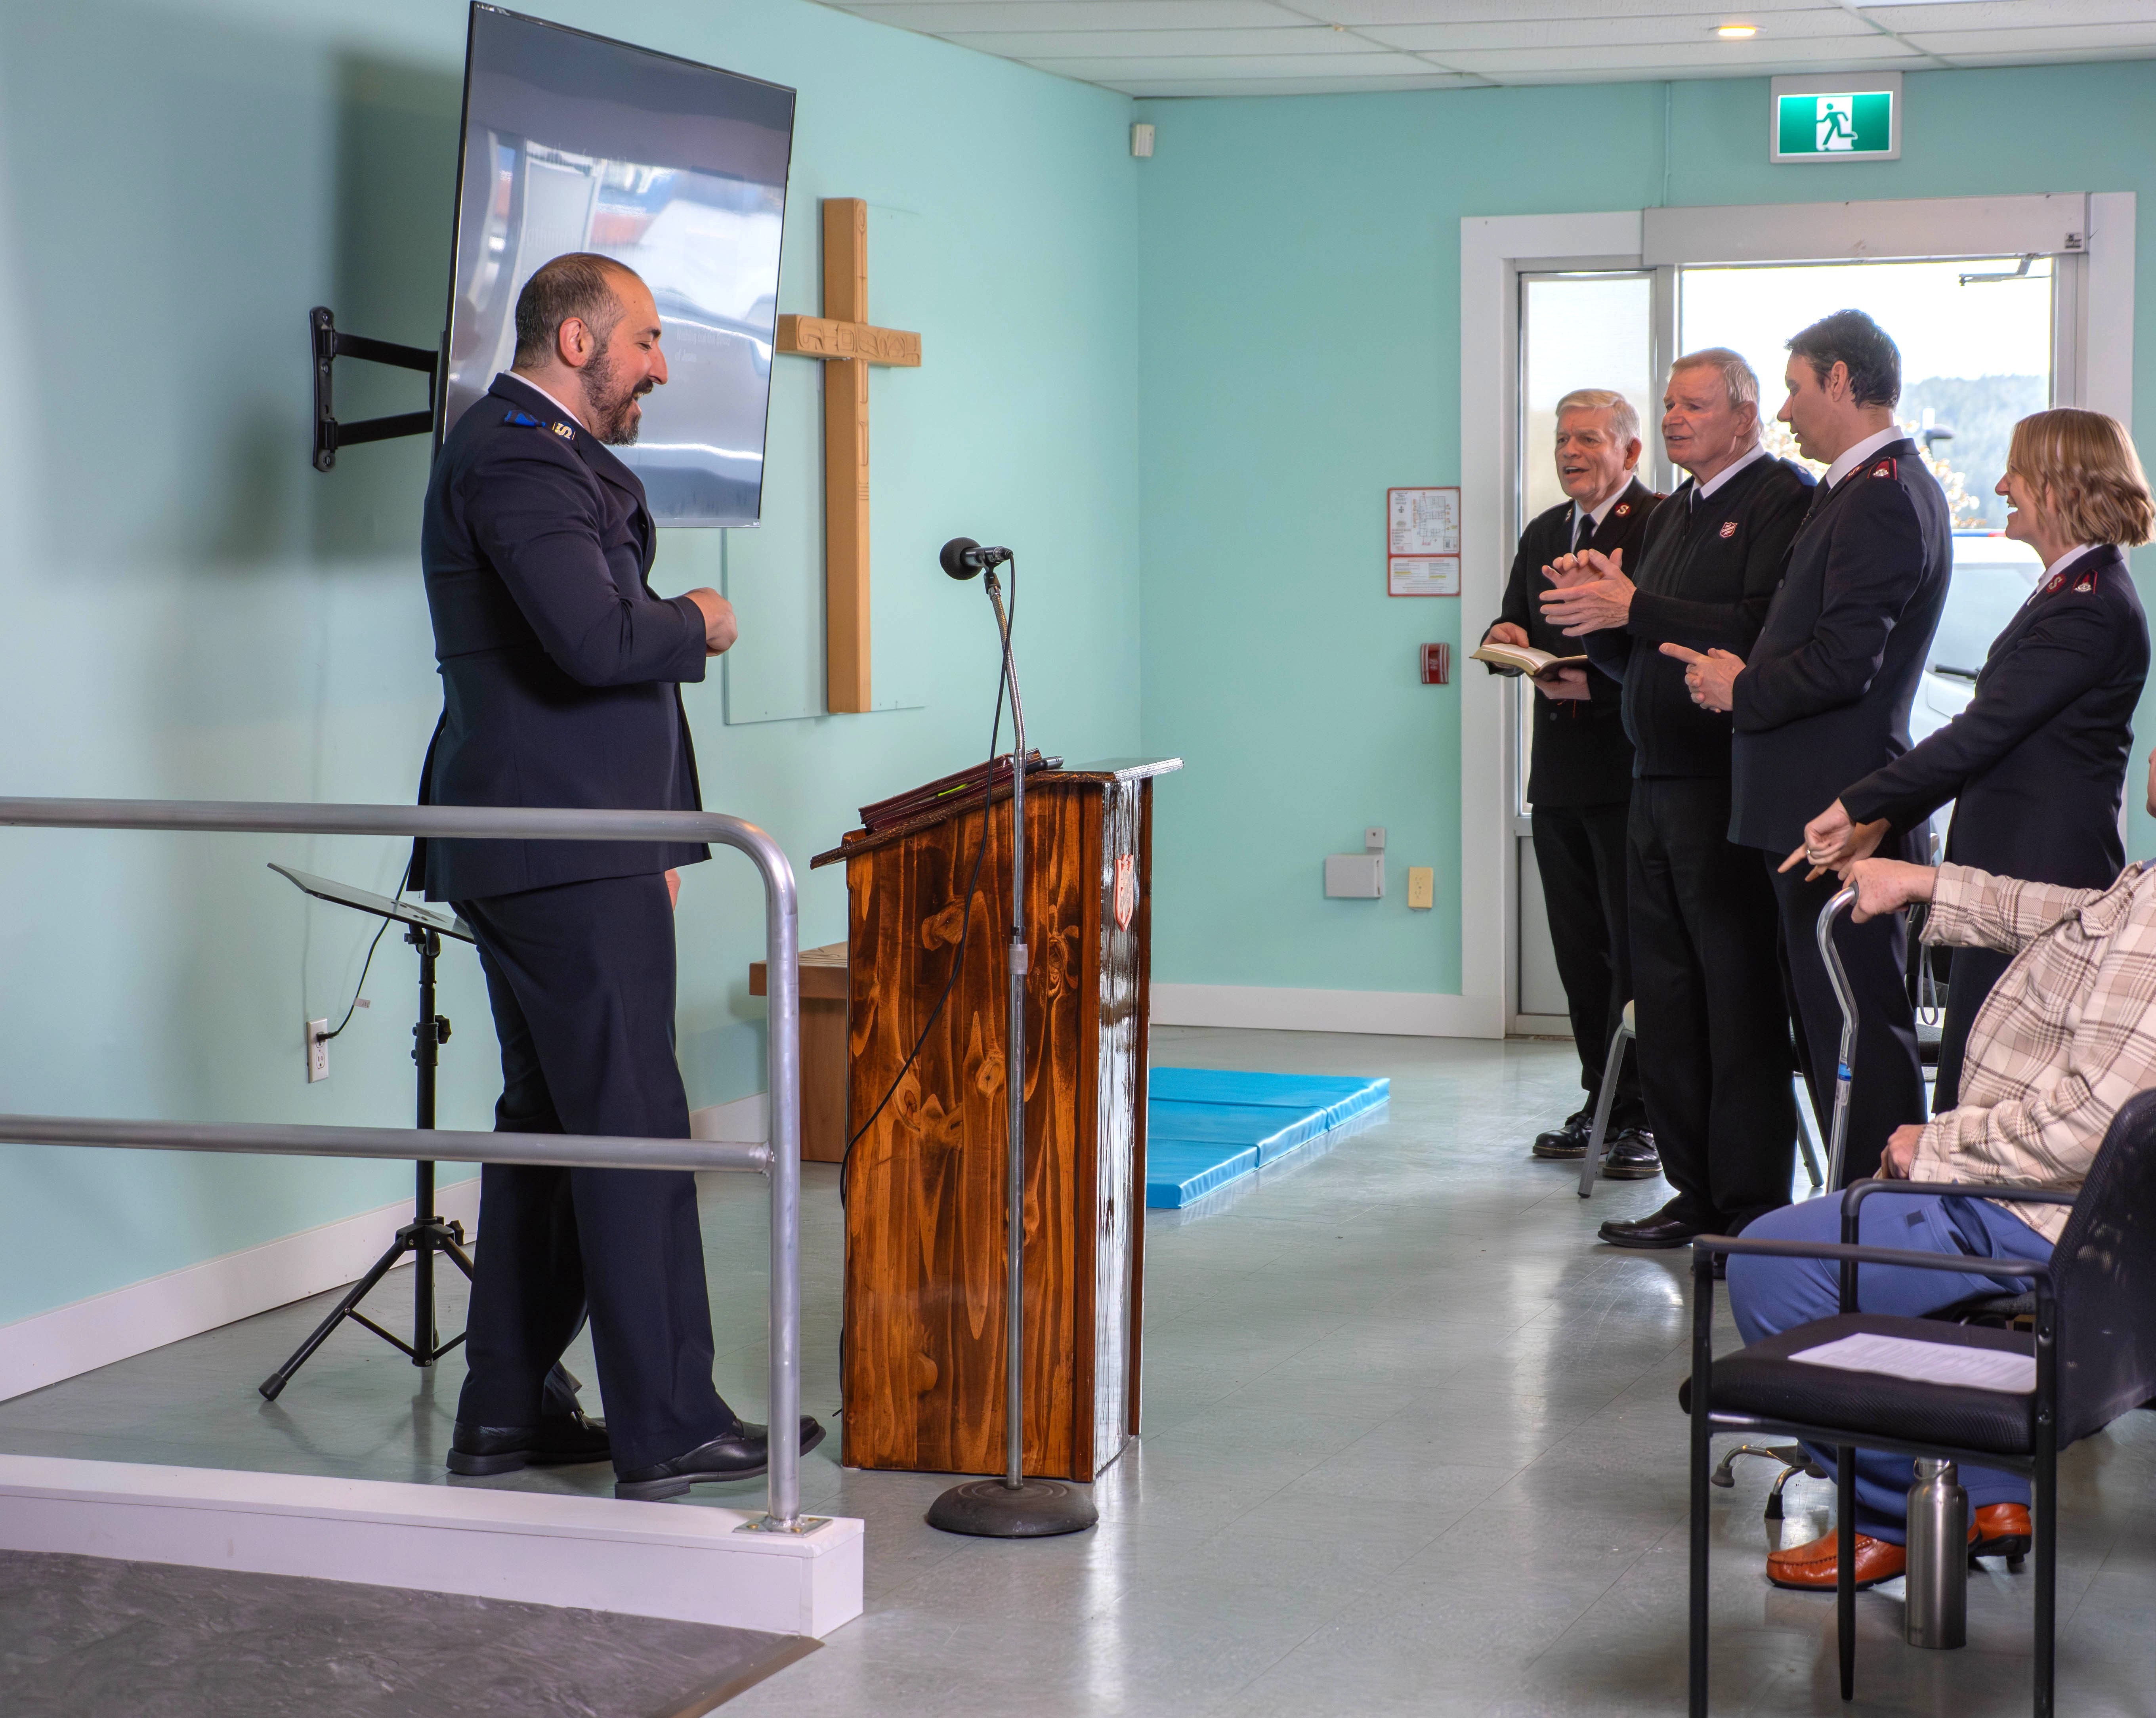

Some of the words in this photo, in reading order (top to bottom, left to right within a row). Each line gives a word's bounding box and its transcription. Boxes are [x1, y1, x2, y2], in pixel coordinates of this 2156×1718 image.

[555, 423, 572, 439] S
[1617, 505, 1629, 514] S
[2049, 576, 2062, 590] S
